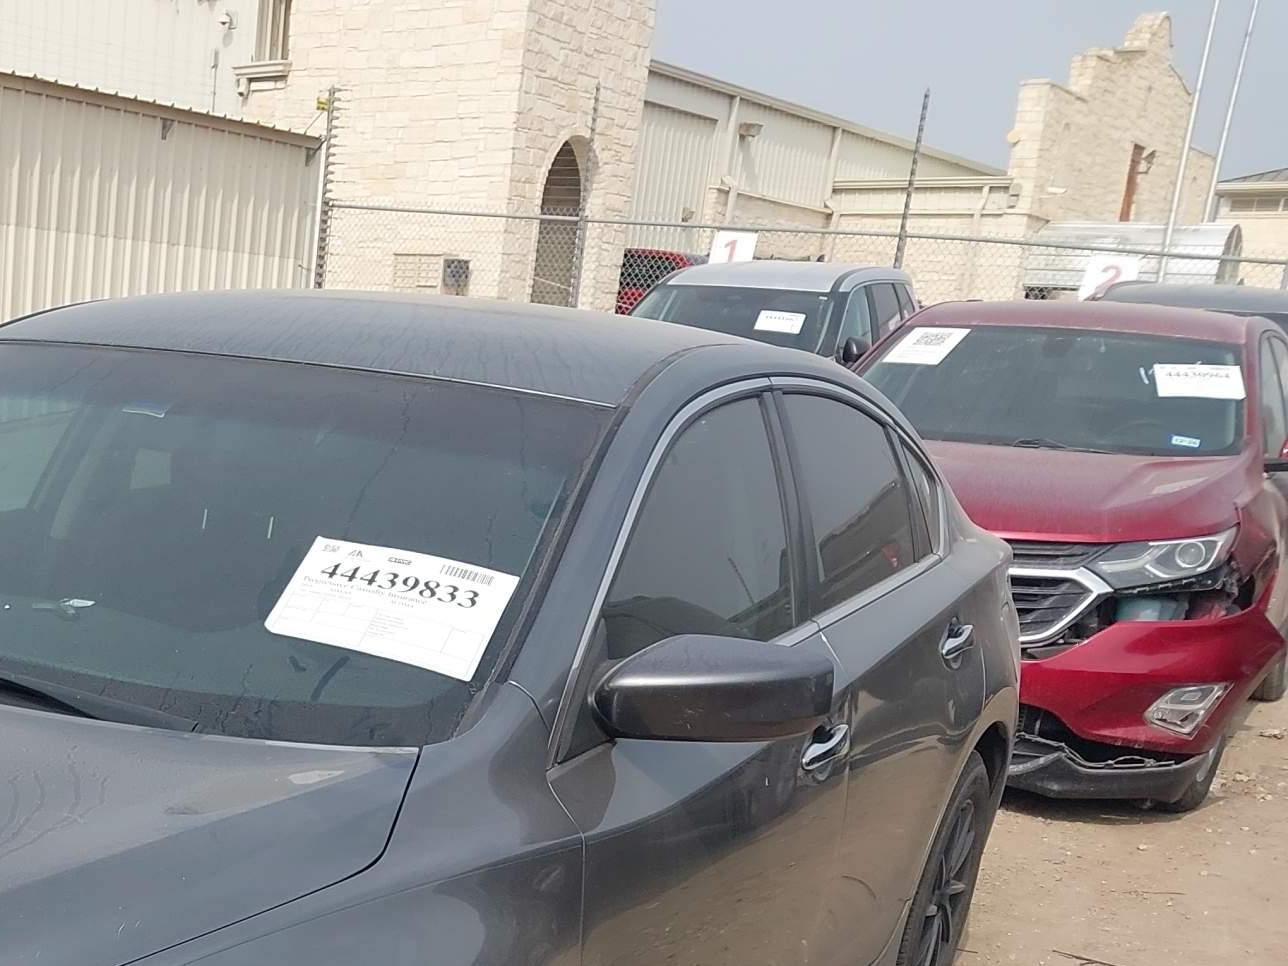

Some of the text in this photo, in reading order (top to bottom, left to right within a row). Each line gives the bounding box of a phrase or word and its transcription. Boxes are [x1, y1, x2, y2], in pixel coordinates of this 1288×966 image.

[724, 240, 739, 263] 1
[1095, 265, 1123, 295] 2
[320, 561, 480, 609] 44439833
